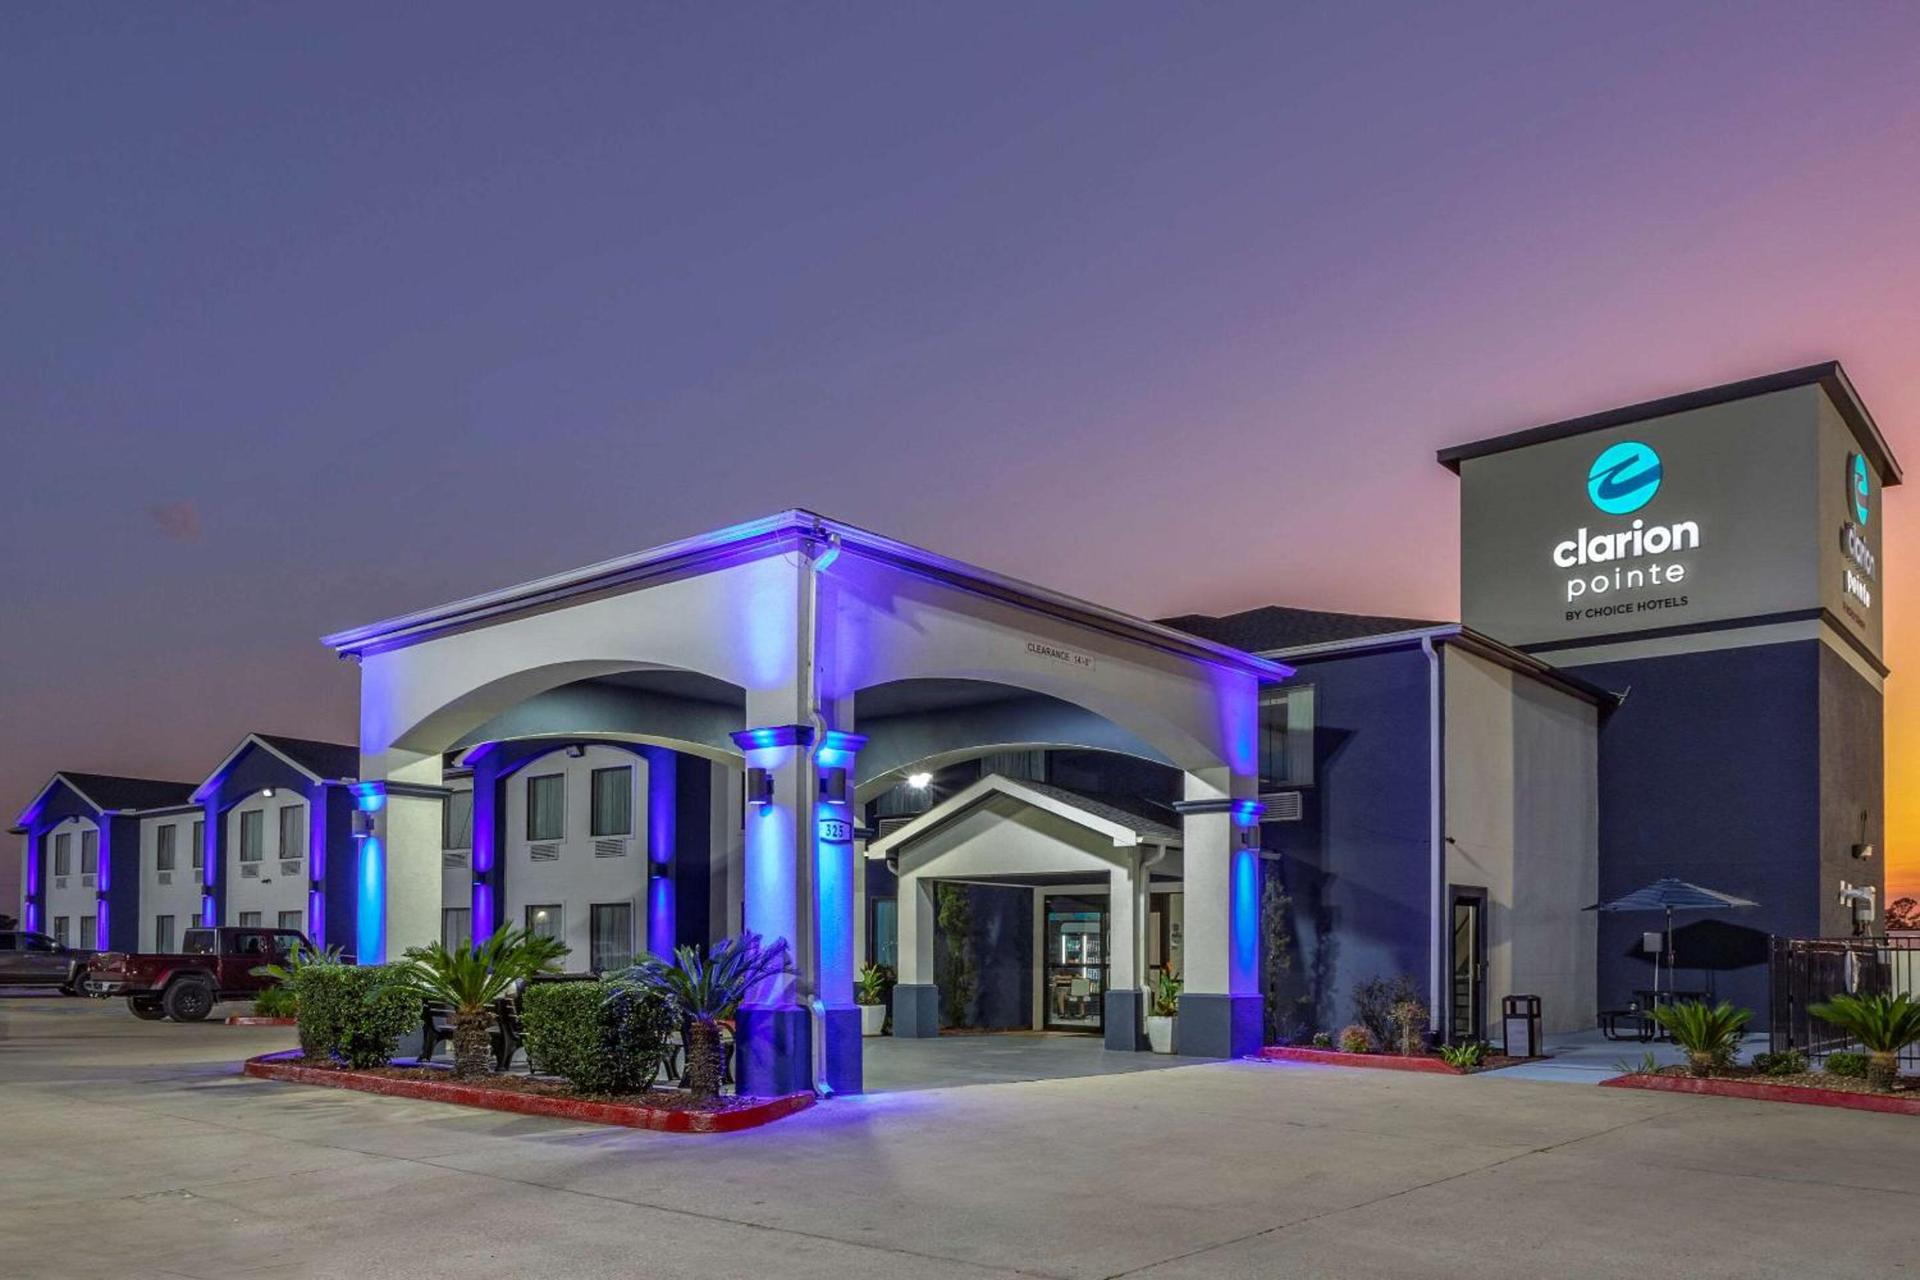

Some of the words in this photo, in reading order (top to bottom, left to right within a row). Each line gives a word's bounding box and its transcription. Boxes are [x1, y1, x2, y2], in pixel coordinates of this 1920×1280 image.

[1553, 518, 1699, 568] clarion
[1567, 563, 1685, 602] pointe
[1565, 610, 1582, 621] BY
[1585, 602, 1634, 618] CHOICE
[1637, 596, 1688, 612] HOTELS
[1027, 642, 1070, 661] CLEARANCE
[825, 823, 844, 838] 325
